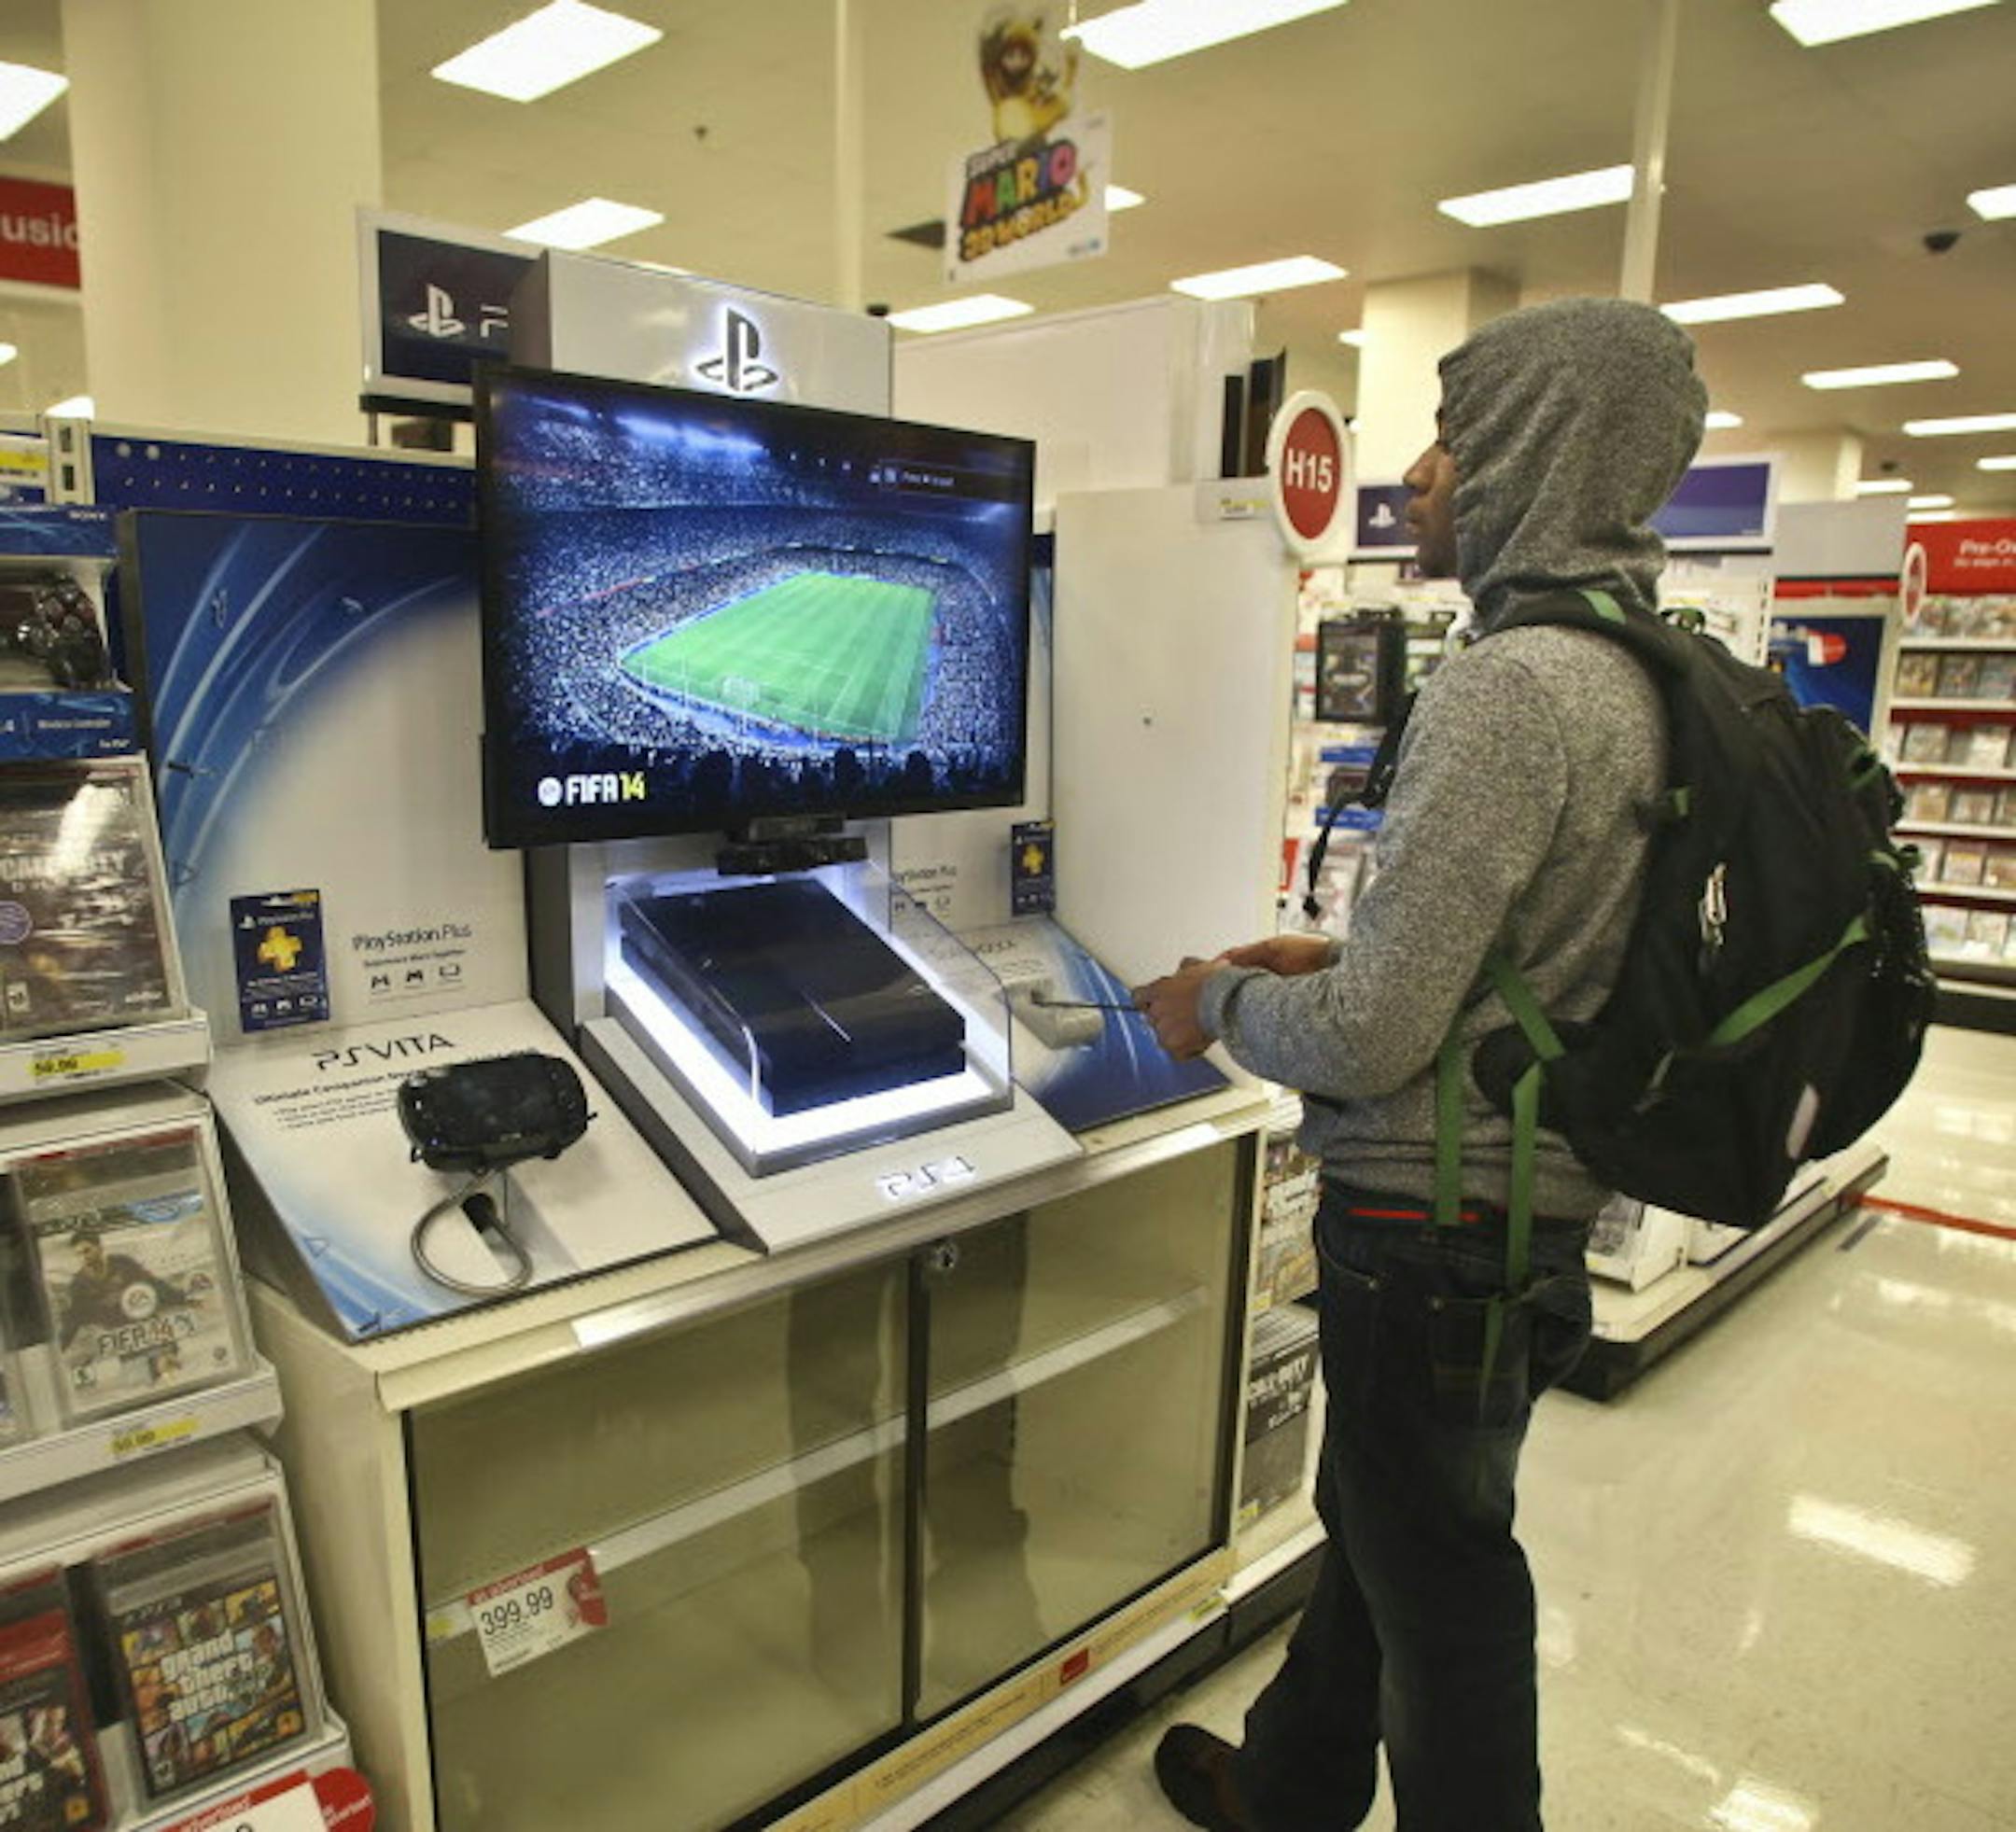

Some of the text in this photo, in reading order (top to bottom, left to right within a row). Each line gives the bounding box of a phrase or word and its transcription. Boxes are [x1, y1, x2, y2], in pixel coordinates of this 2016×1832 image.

[964, 140, 1076, 226] MARIO
[1284, 447, 1334, 494] H15
[566, 772, 645, 806] FIFA 14
[352, 929, 440, 951] PlayStation
[480, 1586, 553, 1636] 399.99
[161, 1629, 234, 1684] grand
[177, 1653, 254, 1695] theft
